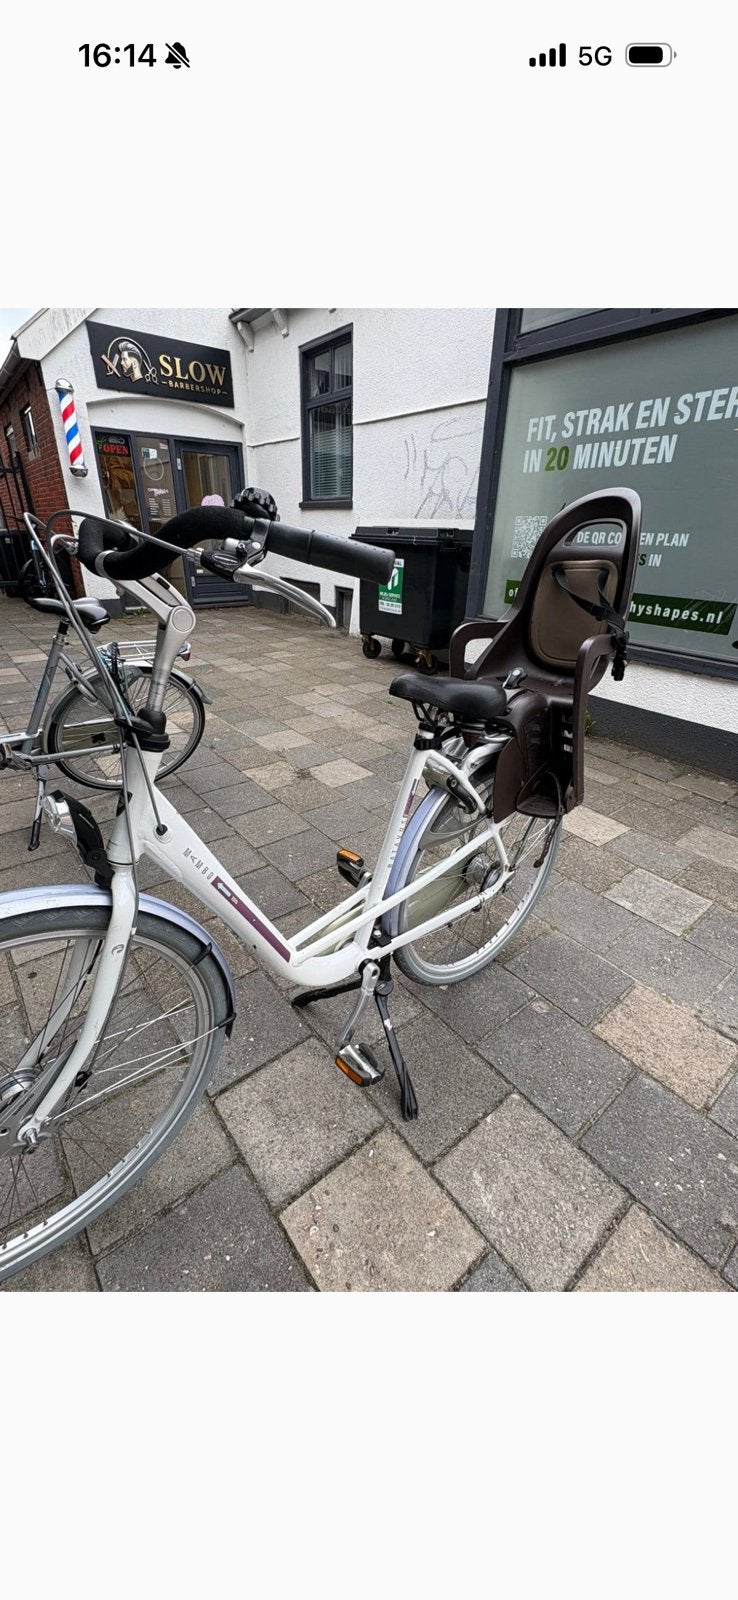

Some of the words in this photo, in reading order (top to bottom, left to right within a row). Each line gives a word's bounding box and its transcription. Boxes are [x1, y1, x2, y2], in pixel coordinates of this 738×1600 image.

[158, 354, 227, 386] SLOW
[168, 380, 222, 395] BARBERSHOP
[526, 414, 558, 444] FIT,
[561, 402, 635, 439] STRAK
[635, 396, 671, 430] EN
[102, 443, 130, 455] OPEN
[522, 448, 543, 474] IN
[544, 445, 570, 473] 20
[572, 433, 679, 471] MINUTEN
[576, 531, 590, 544] DE
[591, 531, 606, 545] QR
[640, 532, 655, 546] EN
[655, 532, 690, 547] PLAN
[648, 553, 662, 568] IN
[183, 847, 215, 881] MAMBO
